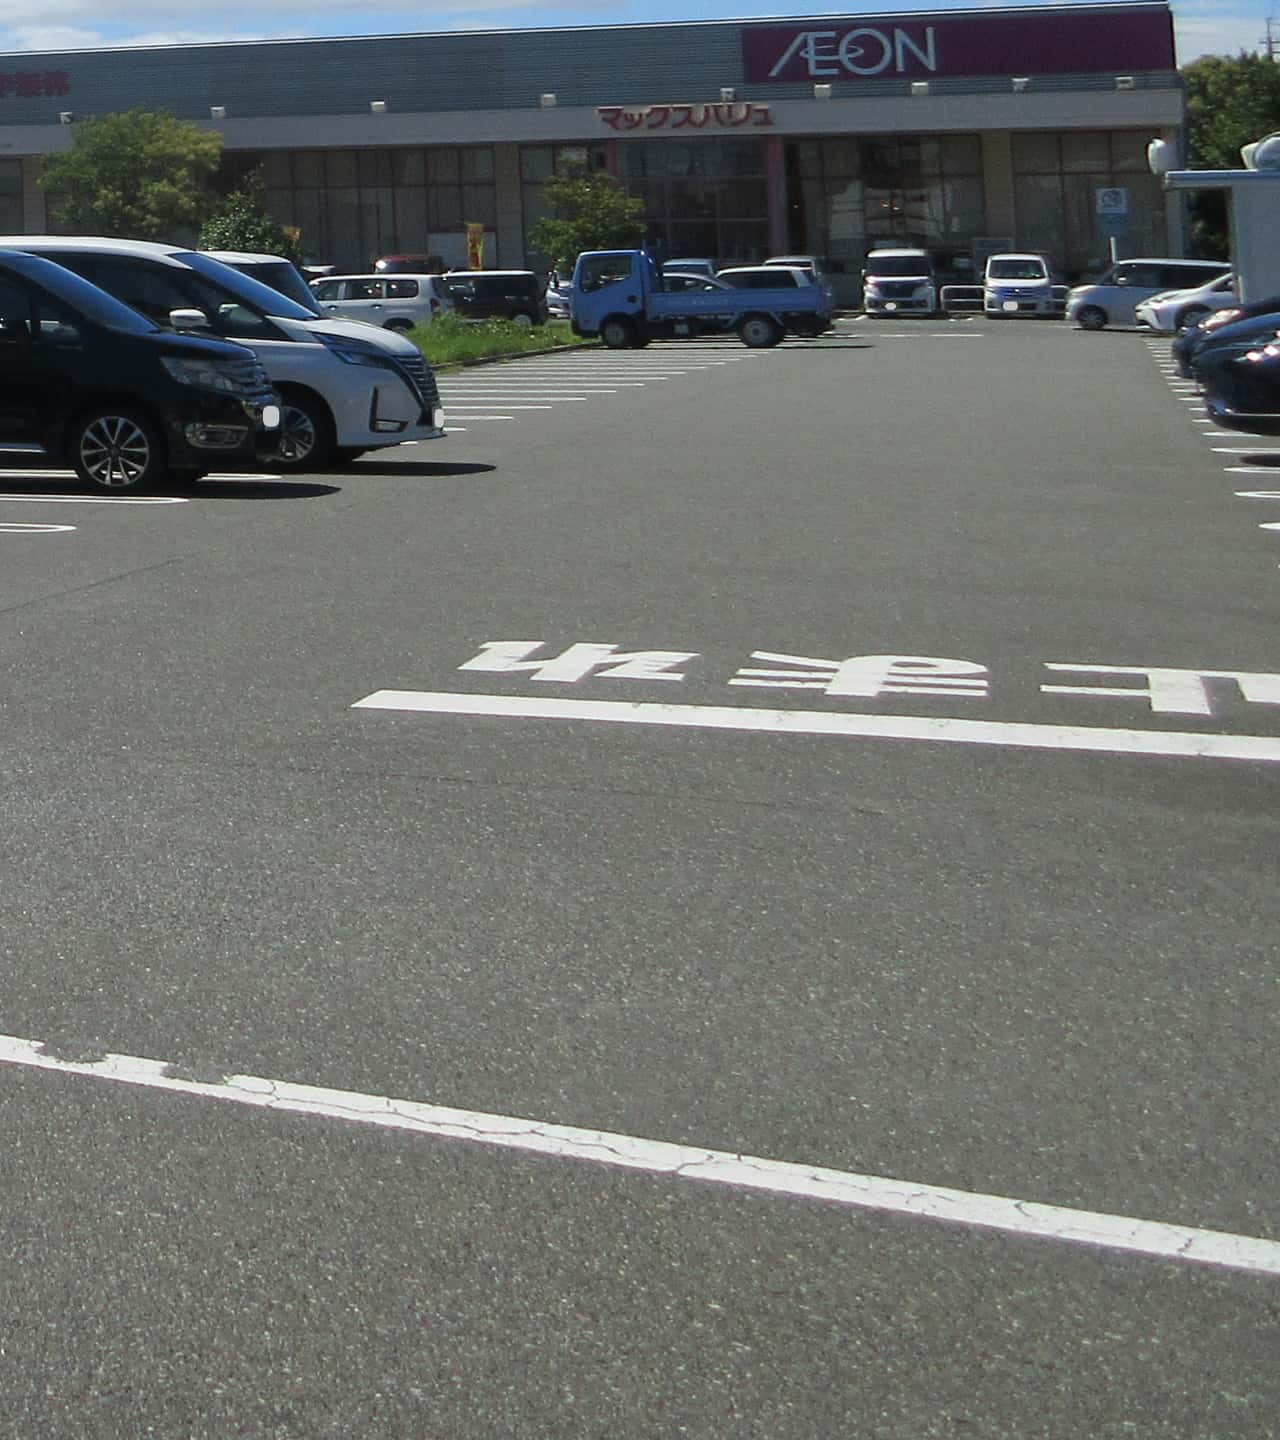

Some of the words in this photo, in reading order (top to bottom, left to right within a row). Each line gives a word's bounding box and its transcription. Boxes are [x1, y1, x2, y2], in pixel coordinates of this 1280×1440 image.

[597, 101, 775, 131] マックスバリュ
